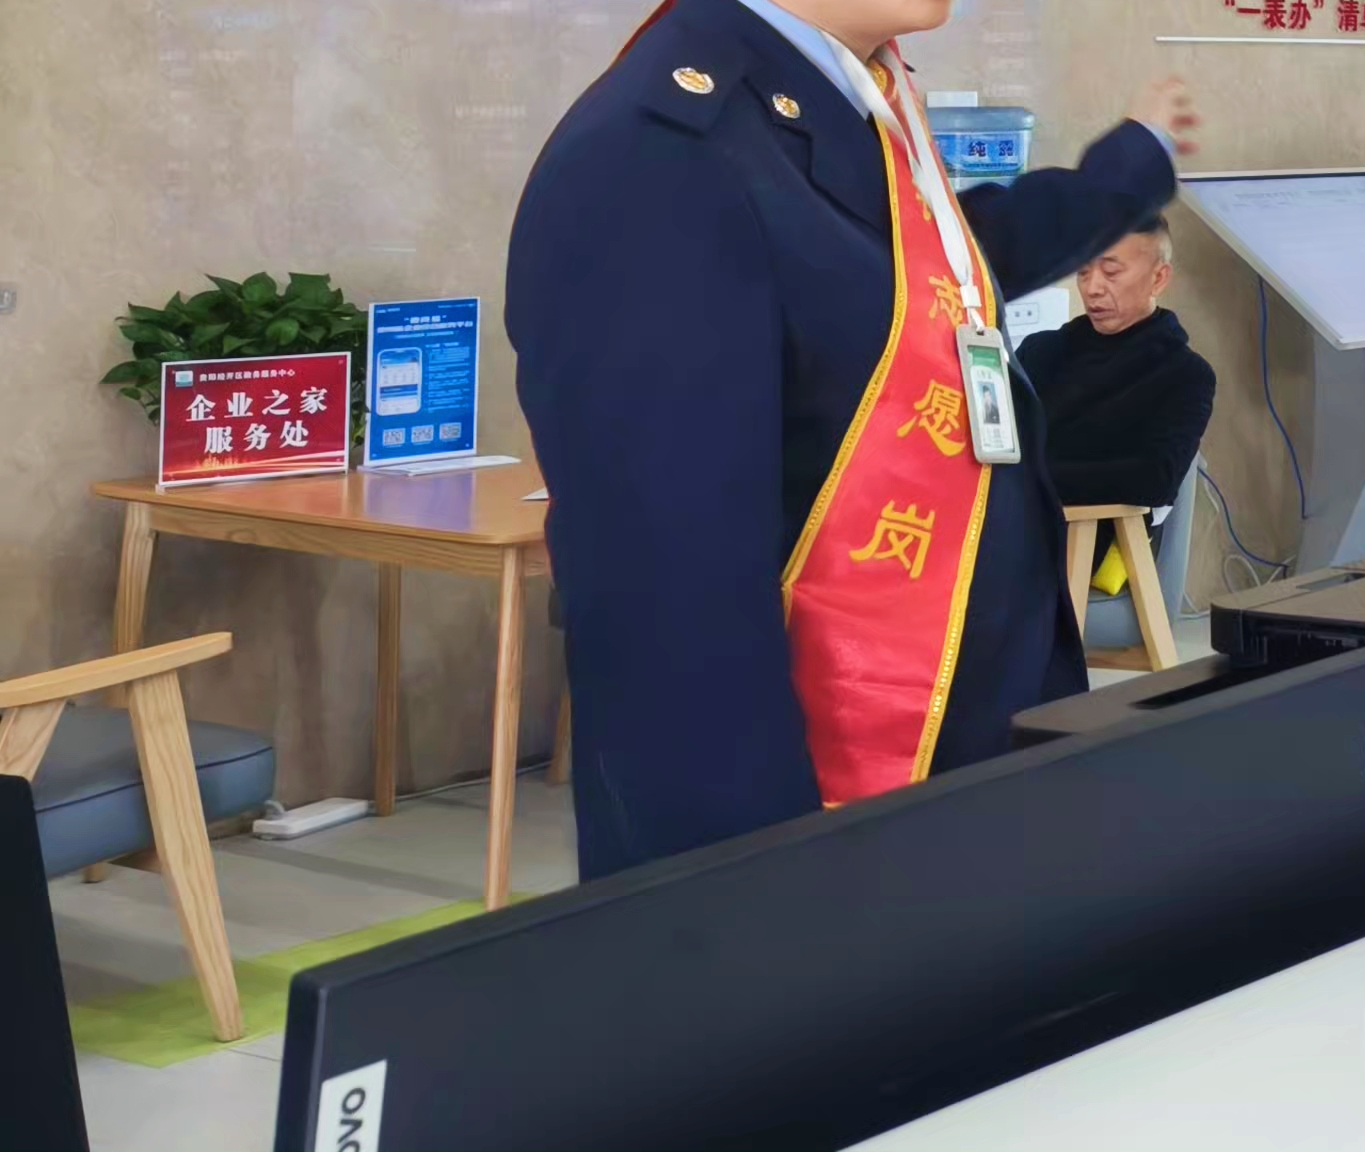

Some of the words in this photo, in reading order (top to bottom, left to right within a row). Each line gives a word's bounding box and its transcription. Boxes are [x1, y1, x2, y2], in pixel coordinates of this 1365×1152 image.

[185, 386, 328, 422] 企业之家
[204, 419, 310, 455] 服务处
